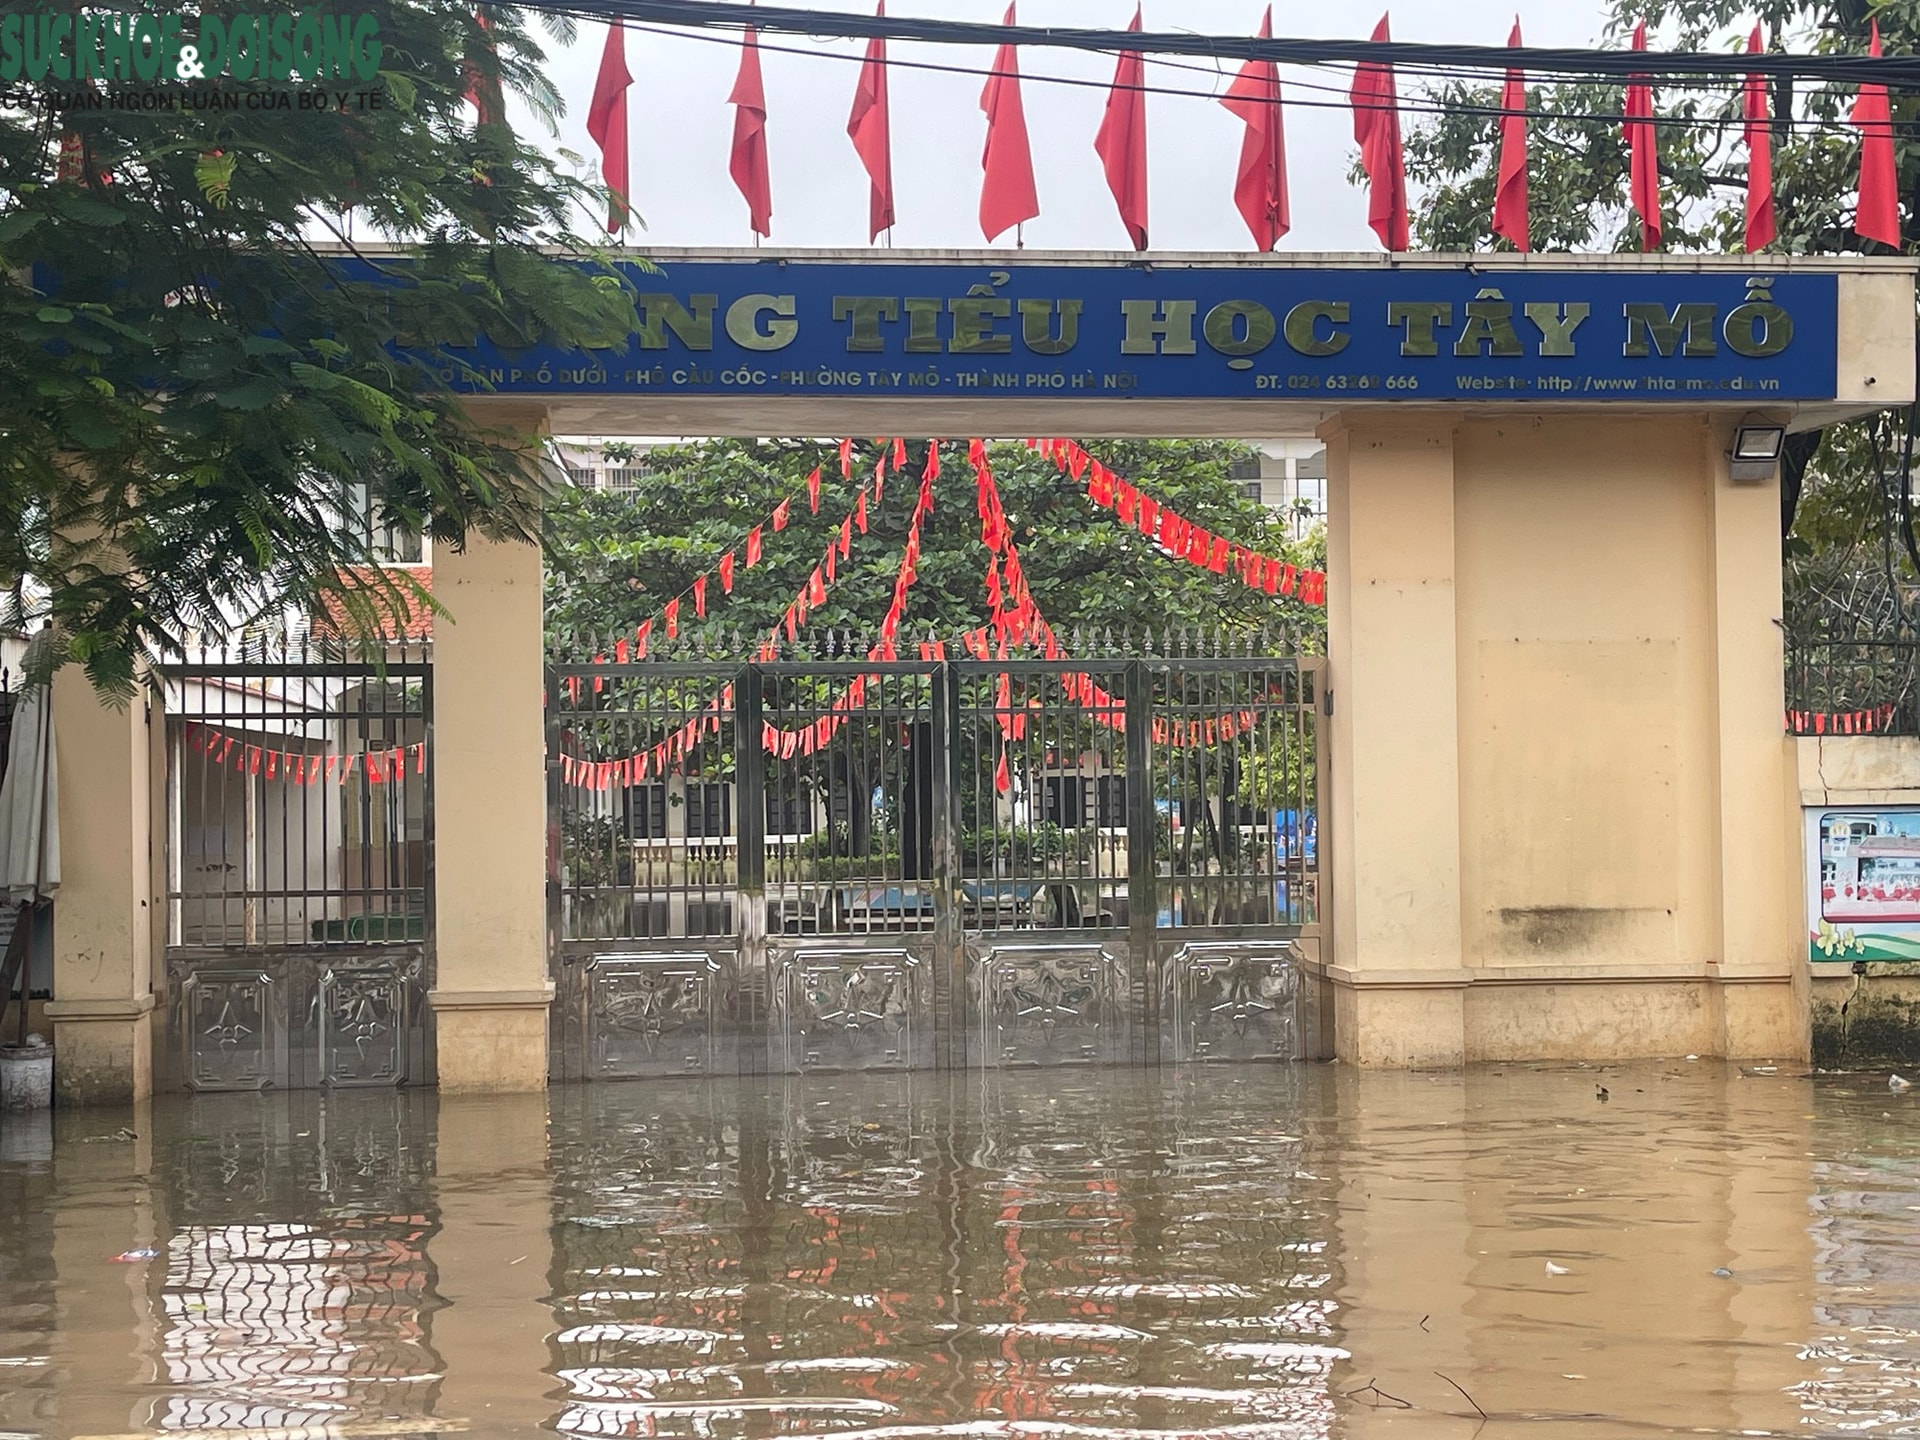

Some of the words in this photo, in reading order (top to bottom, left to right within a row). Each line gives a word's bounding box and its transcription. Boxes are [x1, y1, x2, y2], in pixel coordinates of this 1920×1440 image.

[832, 271, 1083, 355] TIỂU
[1120, 299, 1352, 370] HỌC
[1387, 288, 1590, 358] TÂY
[1623, 276, 1794, 358] MỖ
[559, 364, 607, 384] DƯỚI
[720, 362, 767, 385] CỐC
[780, 364, 862, 386] PHƯỜNG
[867, 368, 902, 387] TÂY
[956, 368, 1019, 388] THÀNH
[1071, 368, 1097, 389] HÀ
[1287, 375, 1321, 389] 024
[1385, 375, 1419, 390] 666
